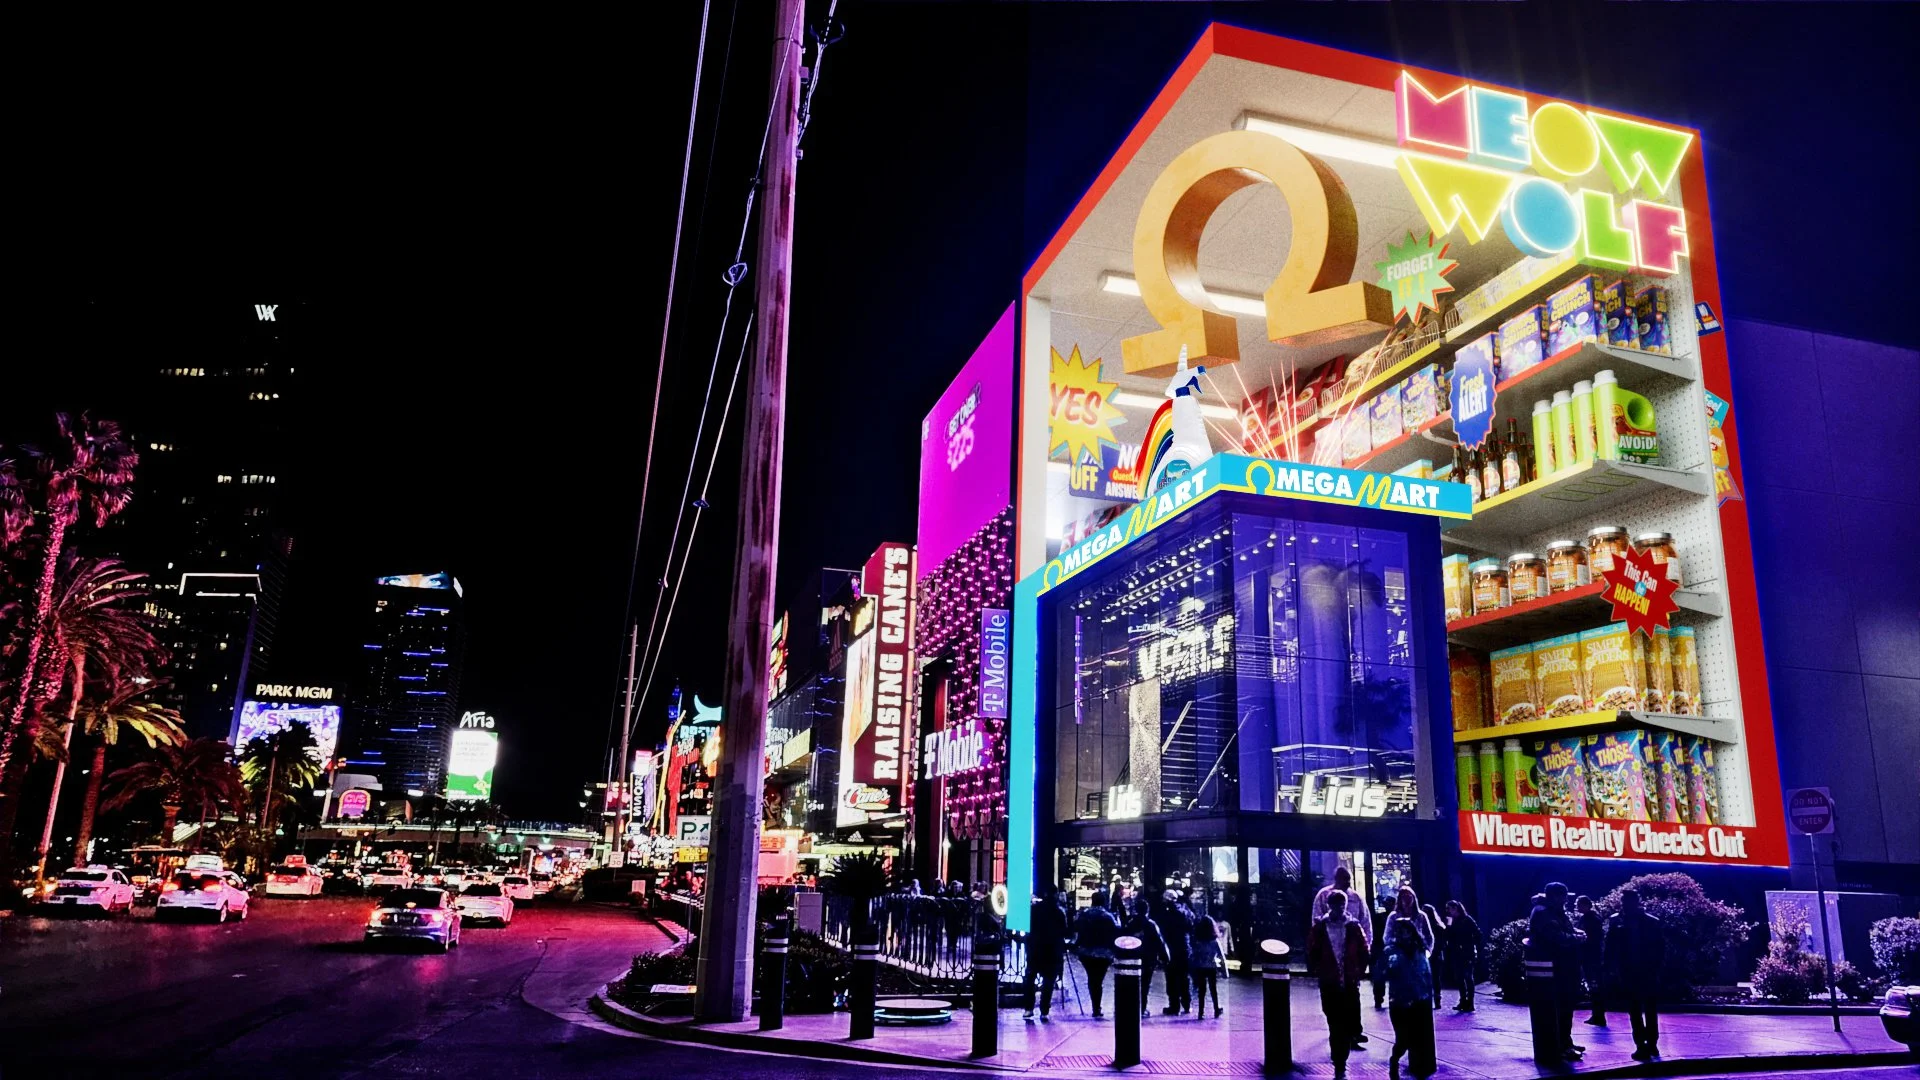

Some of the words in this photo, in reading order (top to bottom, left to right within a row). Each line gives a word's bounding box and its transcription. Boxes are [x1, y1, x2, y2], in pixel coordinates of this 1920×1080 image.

[1396, 69, 1694, 198] MEOW
[1395, 152, 1690, 278] WOLF
[1386, 252, 1434, 282] FORGET
[1050, 382, 1103, 427] YES
[1458, 385, 1488, 423] ALERT
[1105, 481, 1139, 499] ANSWE
[1124, 468, 1208, 538] MART
[1355, 473, 1440, 509] MART
[1623, 559, 1642, 583] This
[1641, 569, 1658, 593] Can
[880, 546, 909, 645] CANE'S
[1587, 635, 1626, 654] SIMPLY
[255, 684, 293, 697] PARK
[295, 686, 333, 699] MGM
[459, 711, 495, 729] Aria
[873, 652, 904, 781] RAISING
[346, 794, 367, 803] CVS
[1107, 784, 1143, 820] Lids
[1300, 774, 1388, 818] Lids
[1794, 798, 1805, 807] DO
[1807, 796, 1823, 805] NOT
[1471, 813, 1546, 848] Where
[1549, 817, 1625, 857] Reality
[1629, 822, 1706, 857] Checks
[1707, 826, 1748, 859] Out
[1800, 816, 1823, 826] ENTER
